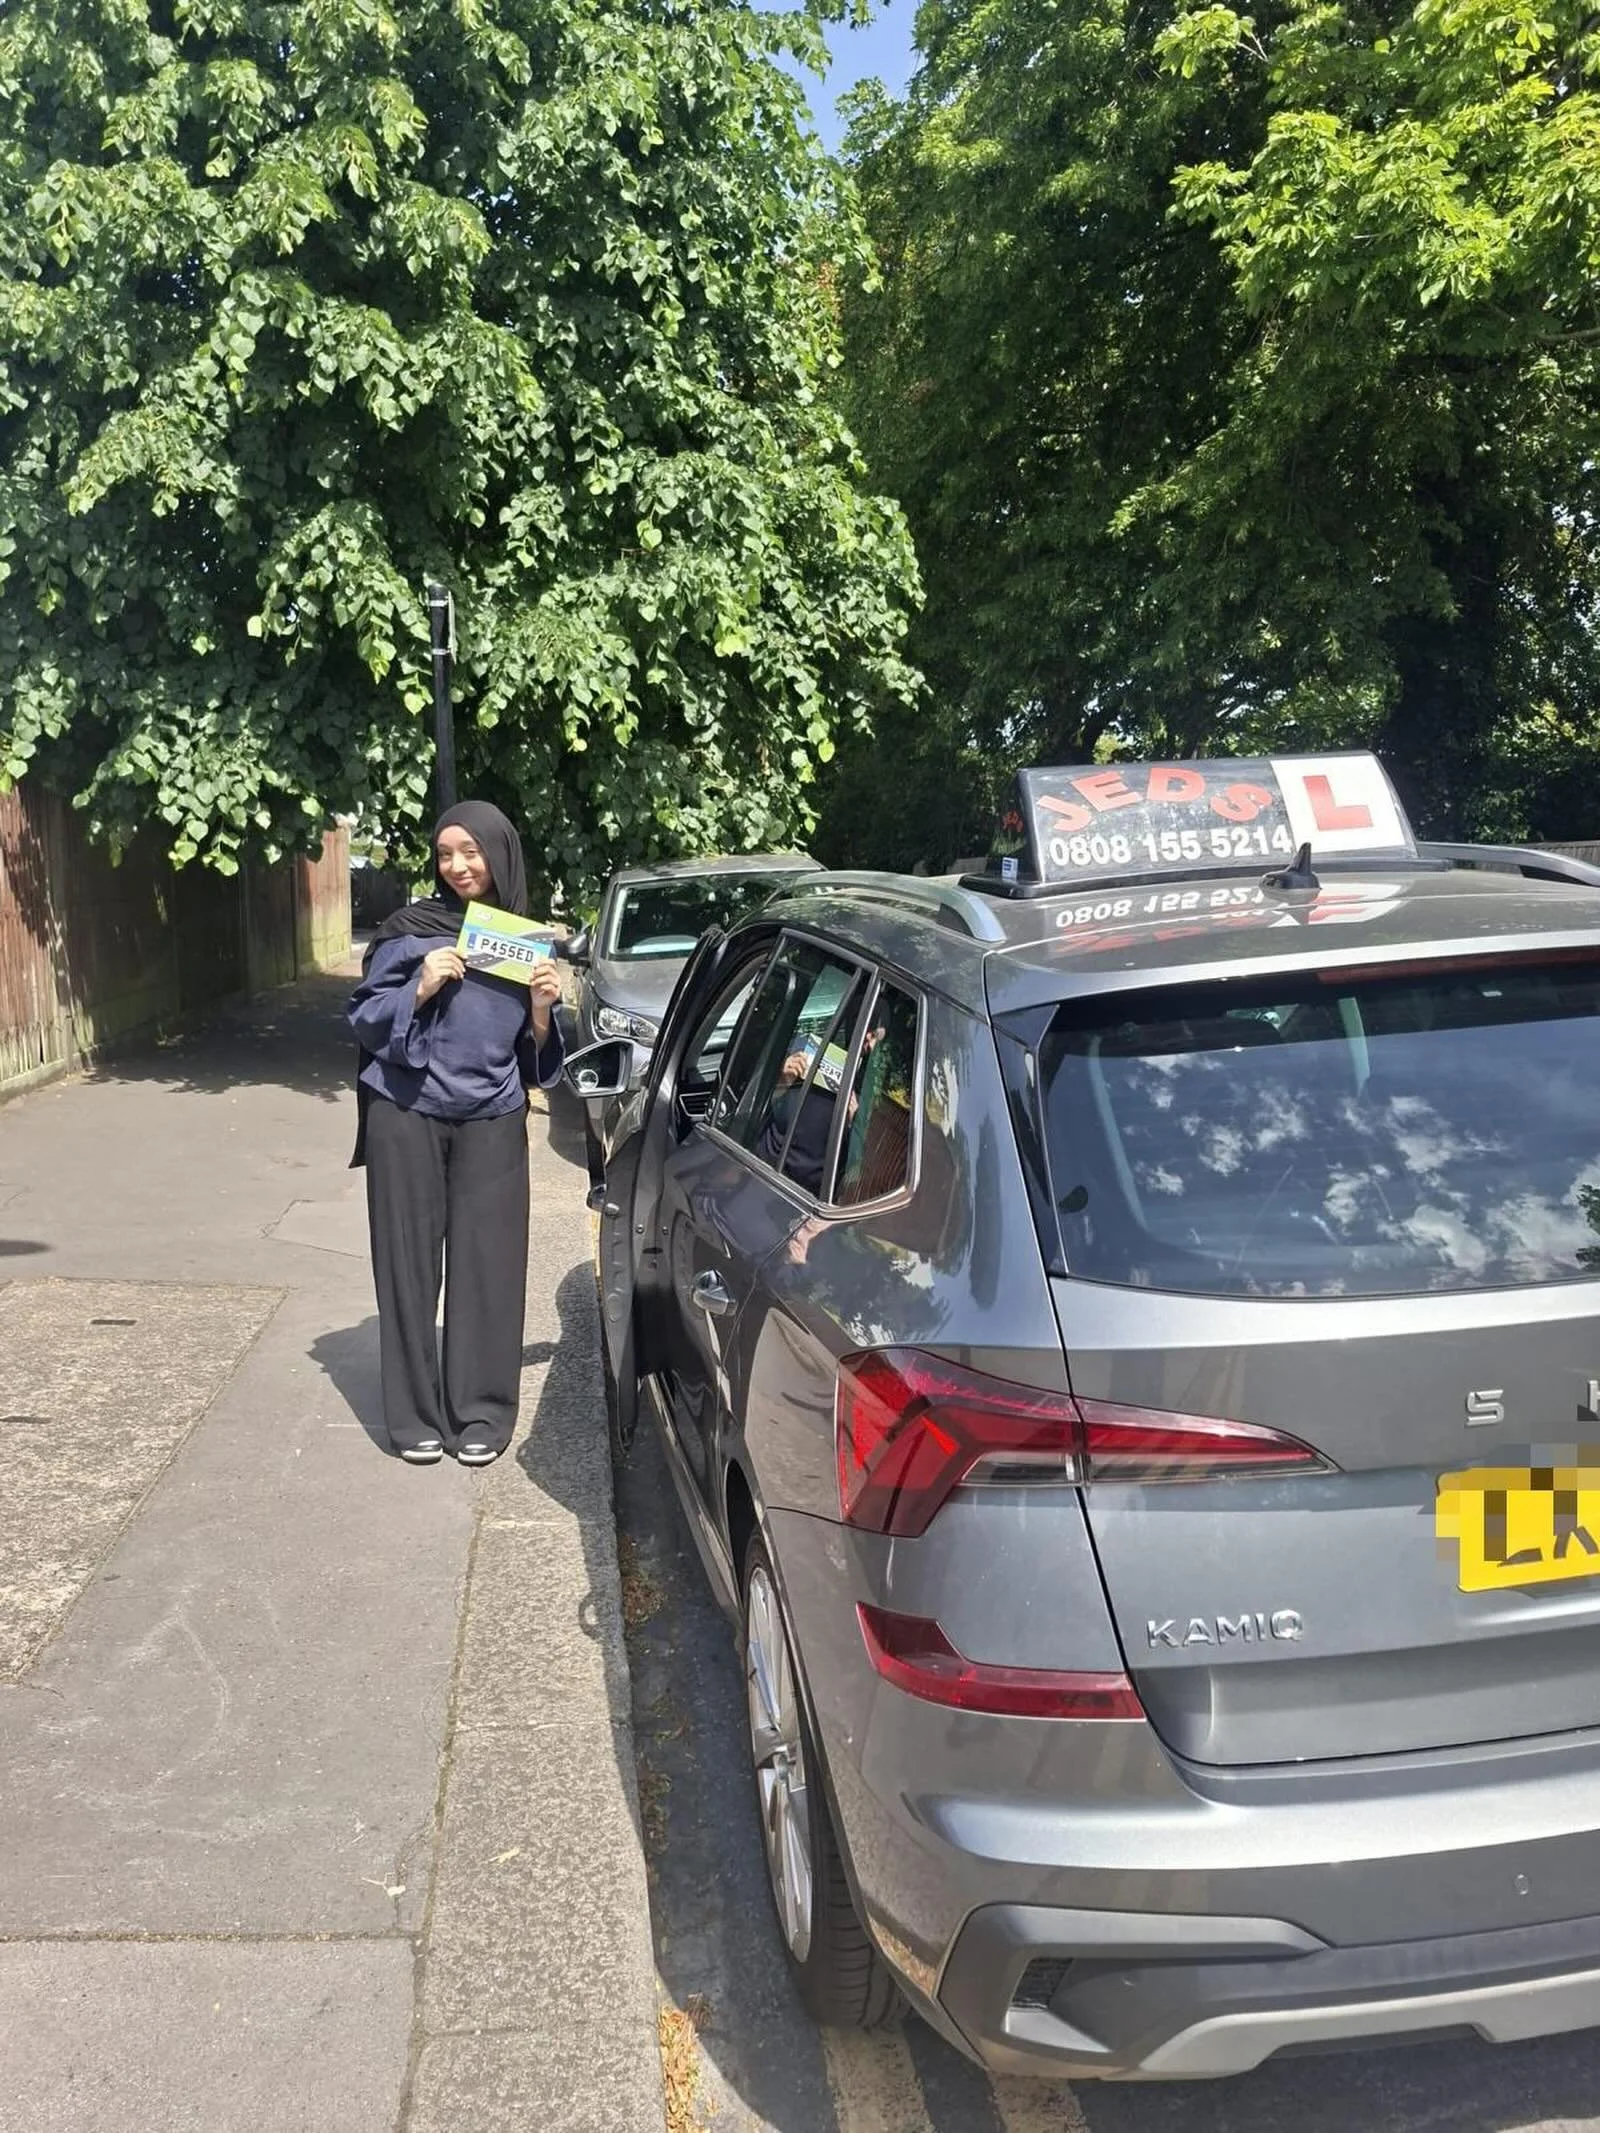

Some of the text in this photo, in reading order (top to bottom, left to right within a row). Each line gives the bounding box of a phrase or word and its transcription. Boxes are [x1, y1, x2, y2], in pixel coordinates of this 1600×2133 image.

[1302, 774, 1374, 832] L
[1050, 825, 1293, 867] 0808 155 5214
[1147, 1609, 1304, 1648] KAMIQ
